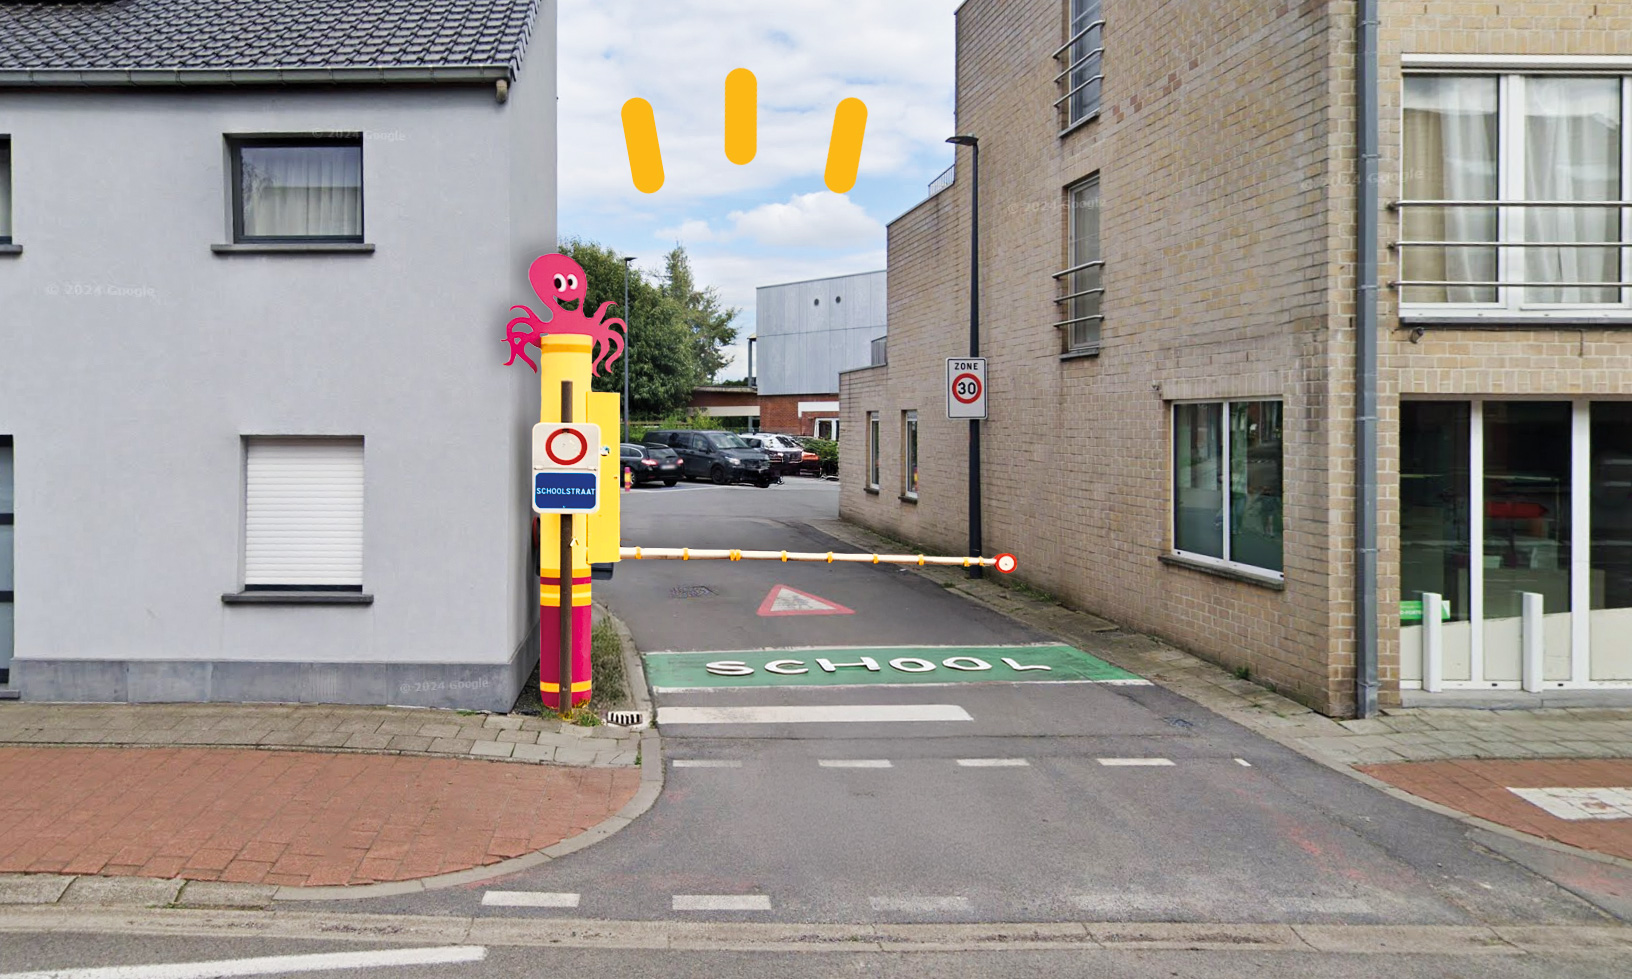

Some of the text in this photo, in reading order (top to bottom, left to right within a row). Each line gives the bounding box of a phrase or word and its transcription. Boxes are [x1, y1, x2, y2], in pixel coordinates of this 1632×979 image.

[954, 362, 978, 370] ZONE
[957, 381, 977, 395] 30
[536, 487, 596, 495] SCHOOLSTRAAT
[705, 655, 1052, 676] SCHOOL
